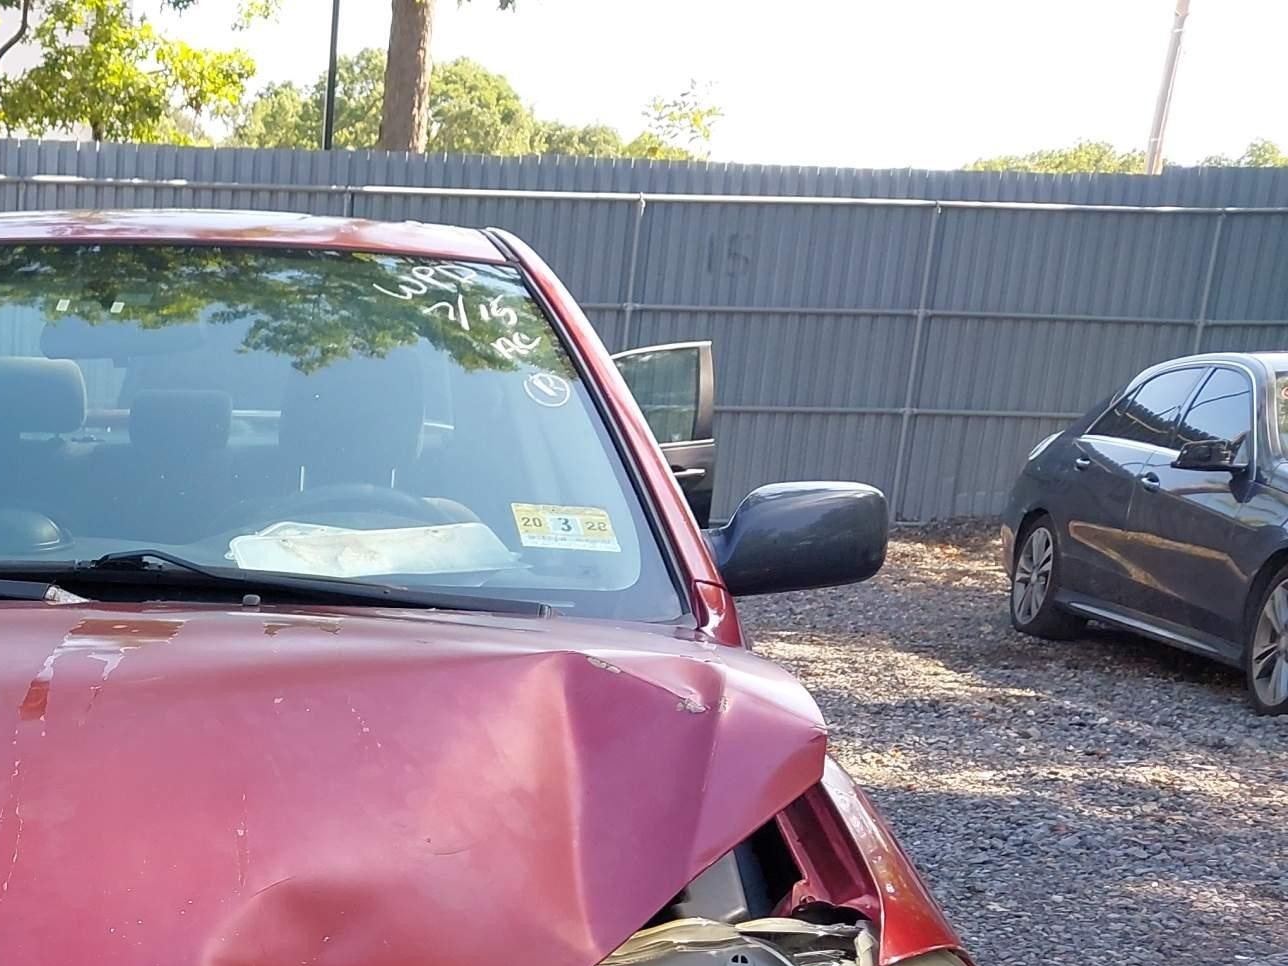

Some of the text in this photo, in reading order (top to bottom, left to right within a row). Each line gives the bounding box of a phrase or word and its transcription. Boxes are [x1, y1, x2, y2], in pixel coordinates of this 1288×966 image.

[422, 293, 519, 332] 7/15
[521, 516, 543, 528] 20
[557, 517, 572, 532] 3
